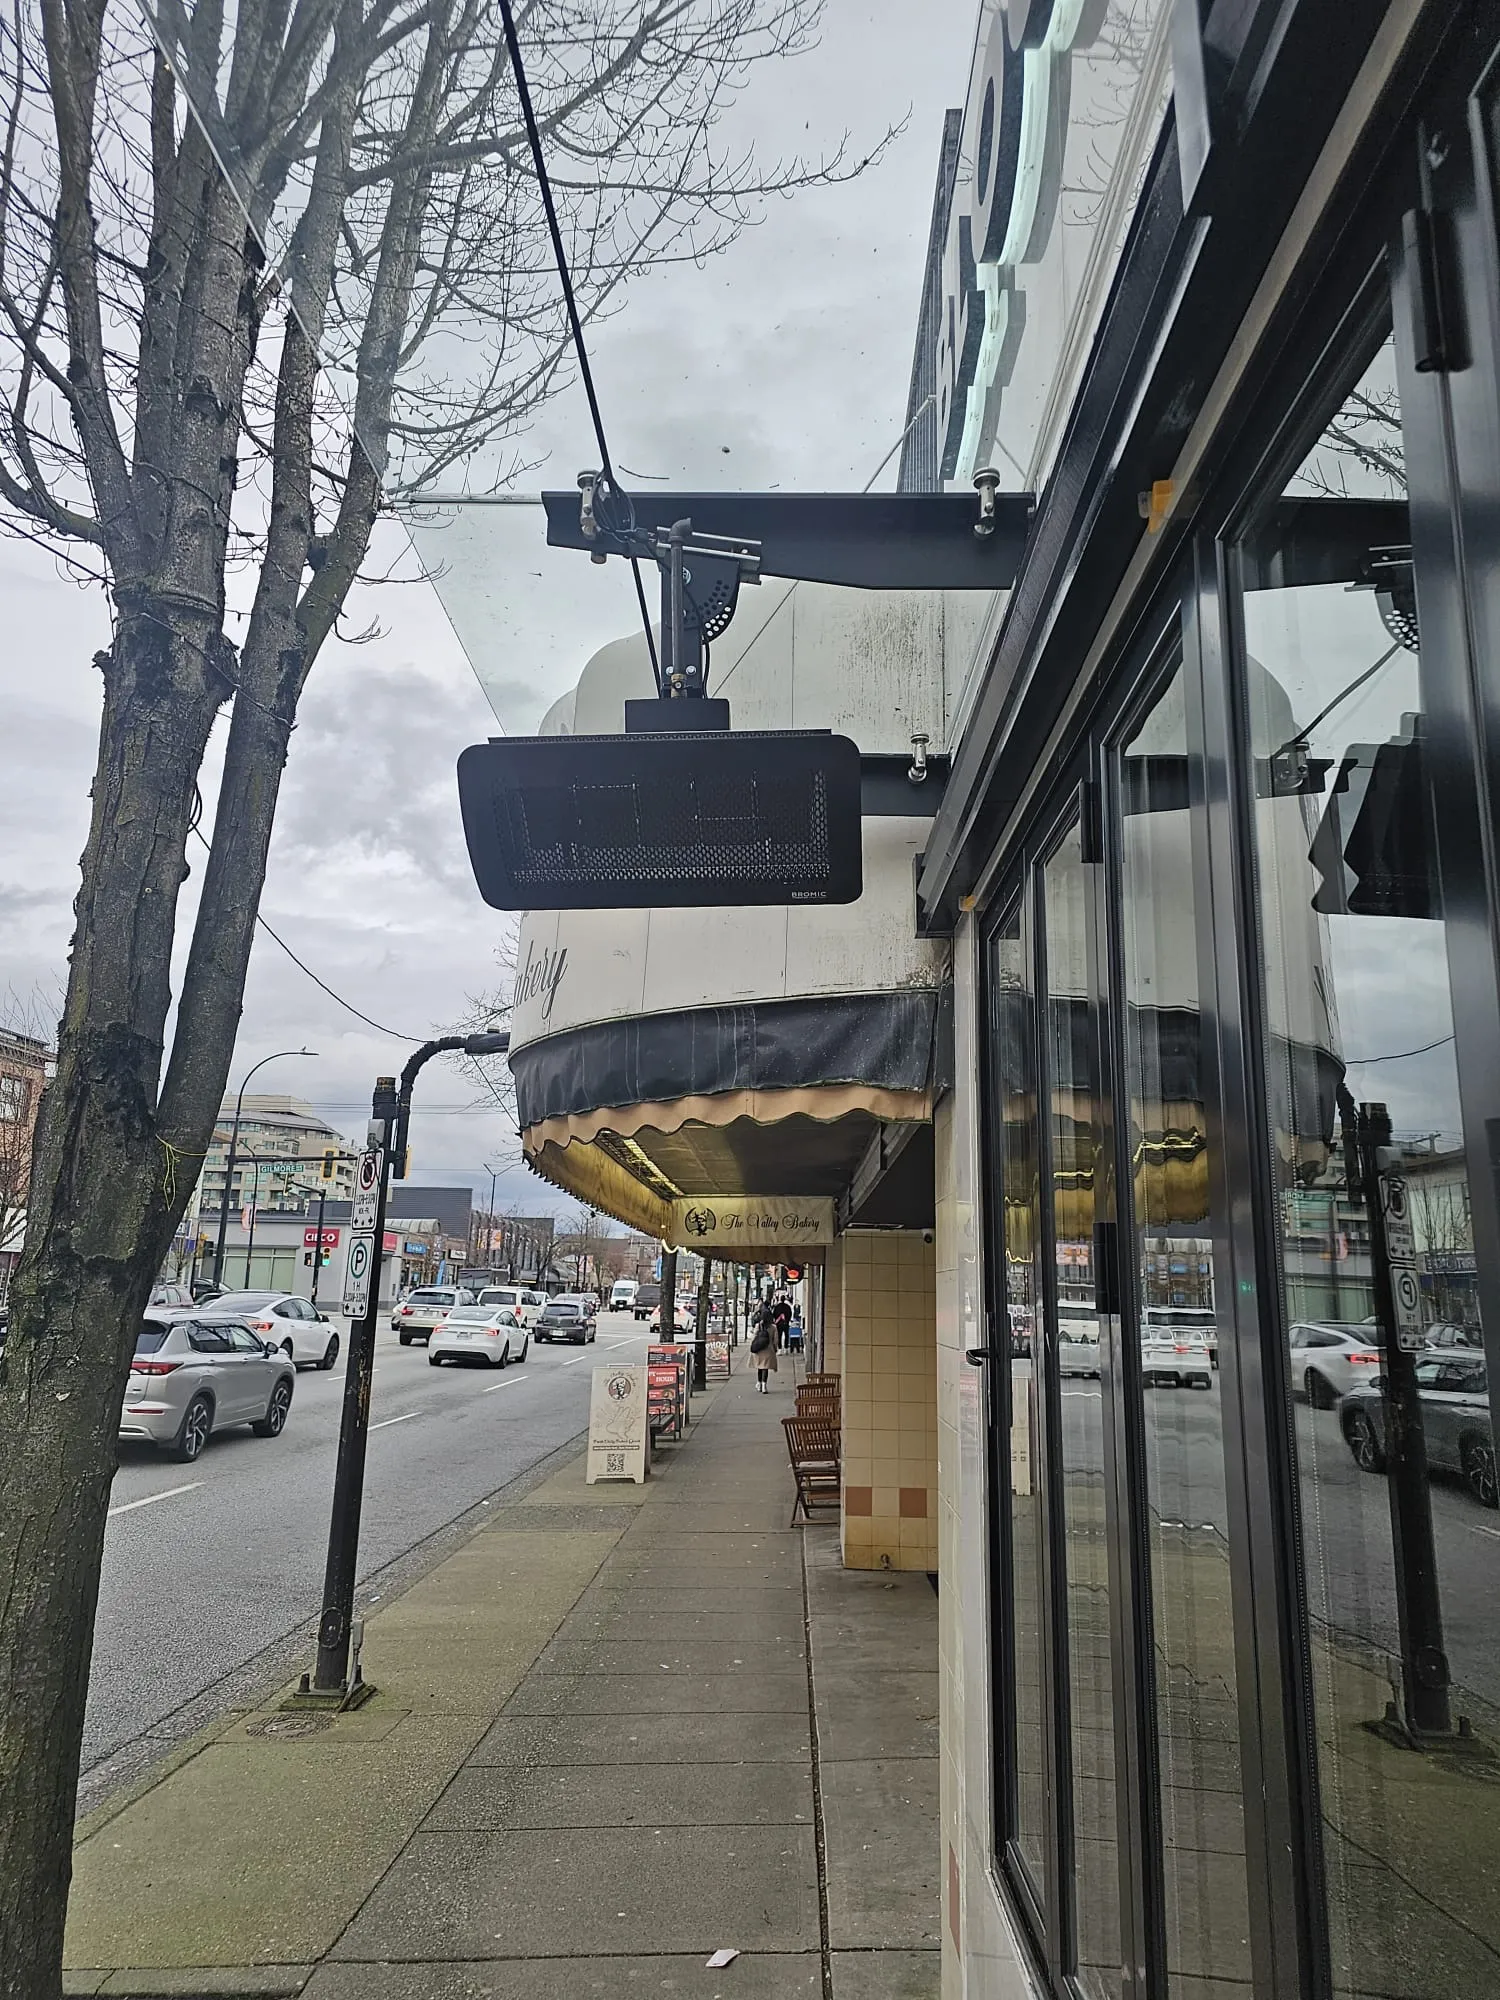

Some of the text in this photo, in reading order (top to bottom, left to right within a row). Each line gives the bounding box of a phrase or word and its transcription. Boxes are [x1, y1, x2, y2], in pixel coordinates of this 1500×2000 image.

[261, 1165, 296, 1173] GILMORE
[721, 1212, 820, 1232] The Valley Bakery
